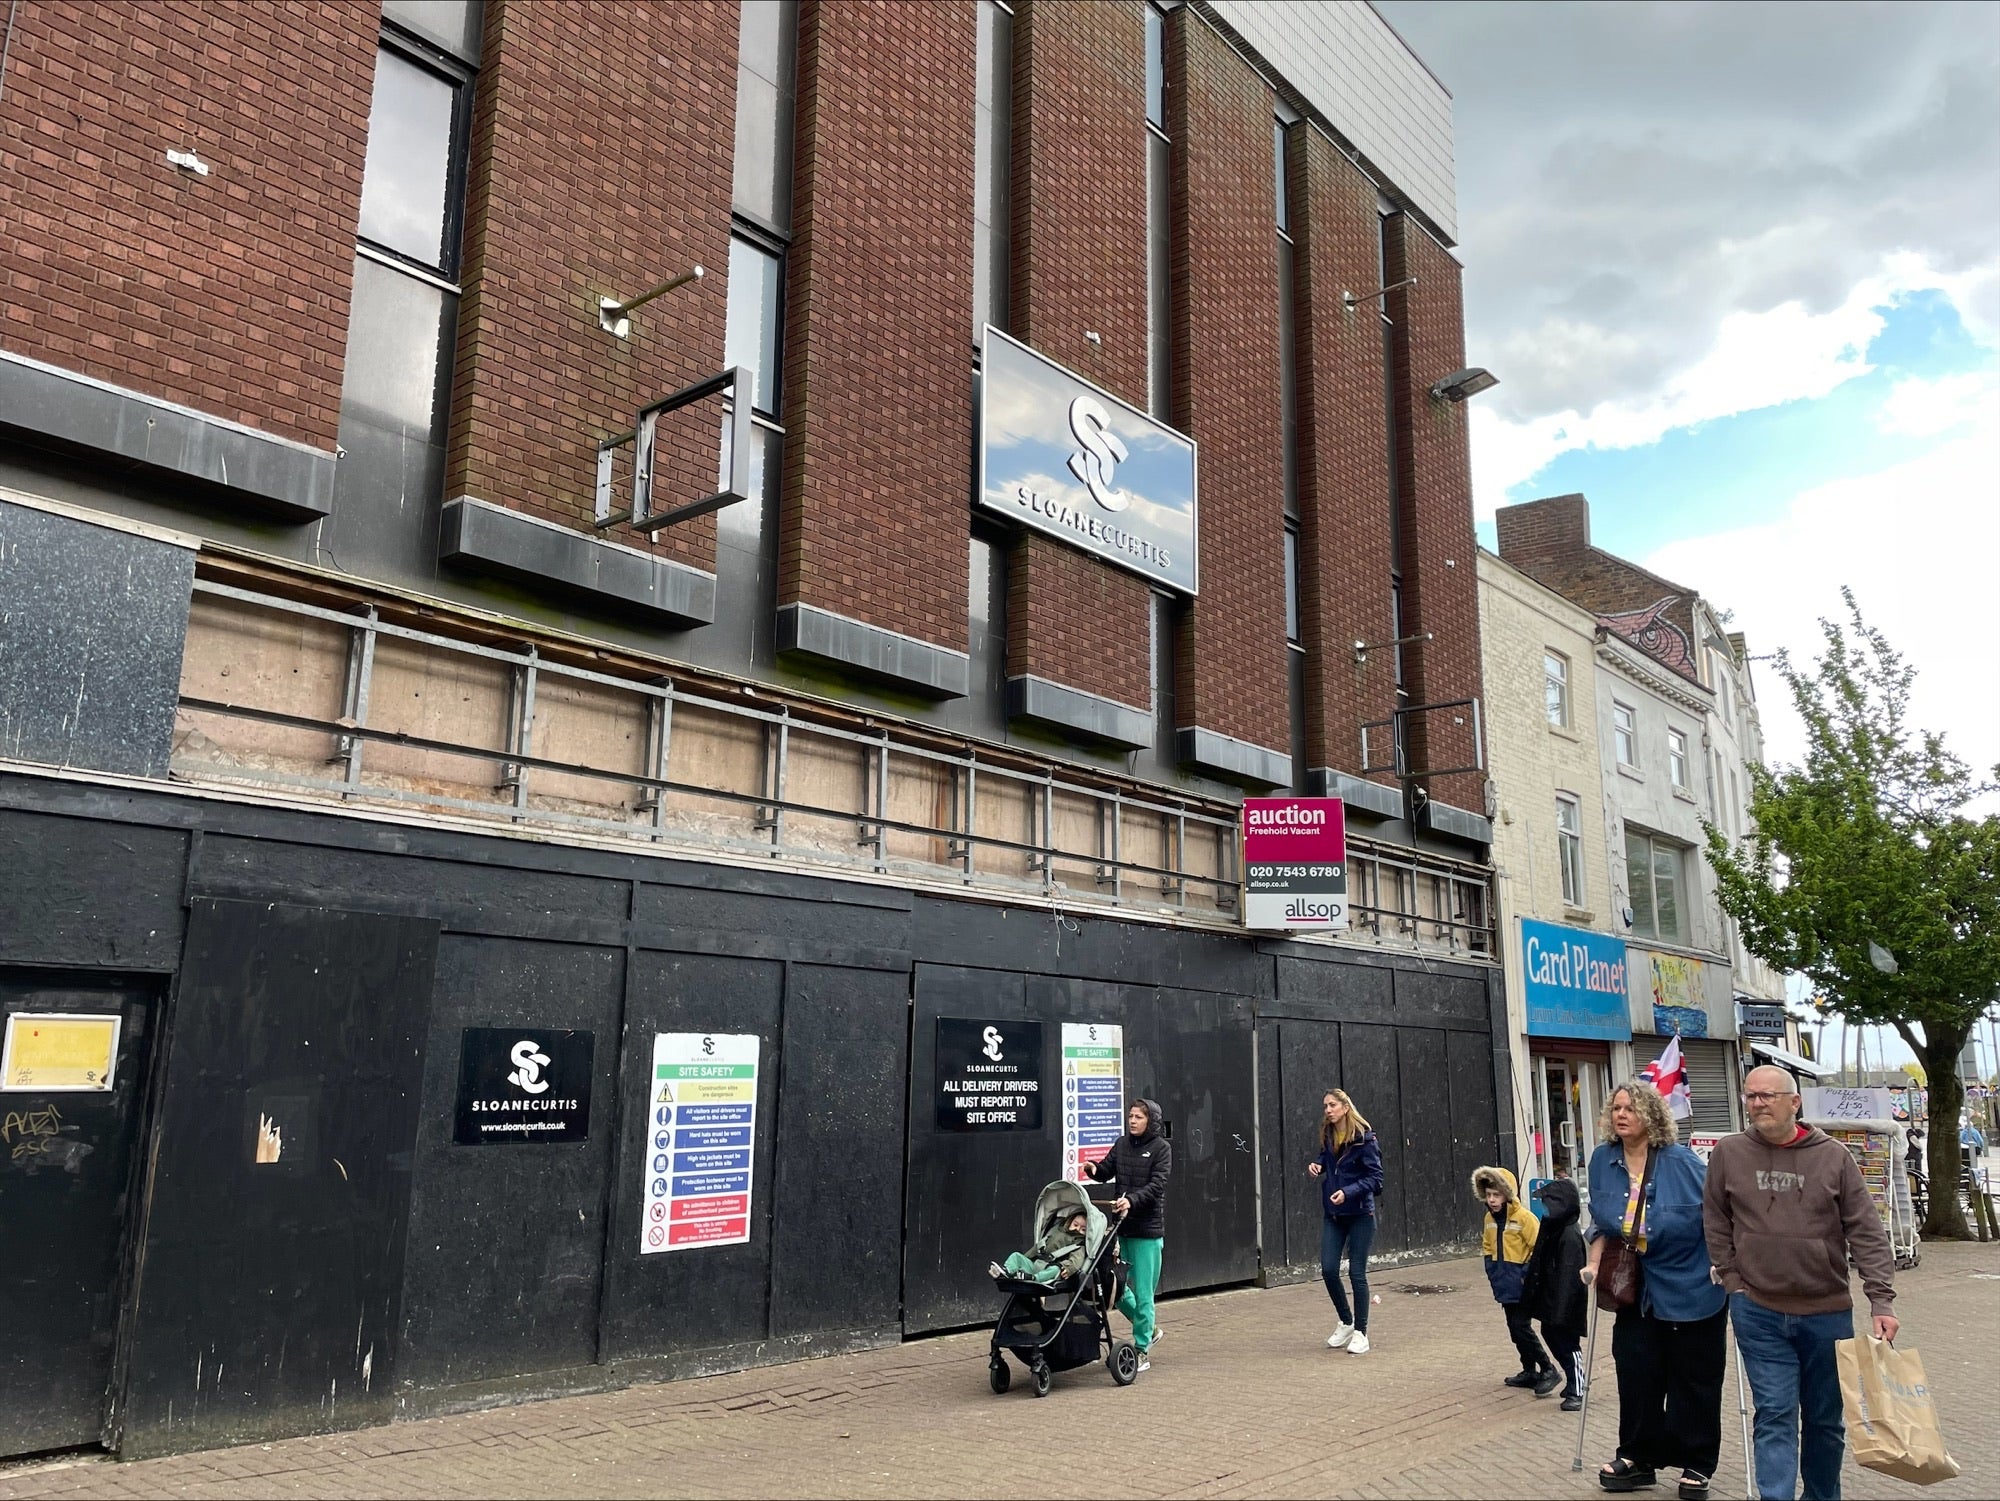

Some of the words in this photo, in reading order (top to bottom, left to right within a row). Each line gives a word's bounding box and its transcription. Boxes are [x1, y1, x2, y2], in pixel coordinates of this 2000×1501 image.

[1018, 487, 1170, 568] SLOANECURTIS
[1249, 804, 1325, 825] auction
[1249, 827, 1288, 835] Freehold
[1290, 827, 1320, 835] Vacant
[1250, 866, 1273, 877] 020
[1275, 866, 1307, 877] 7543
[1309, 866, 1340, 877] 6780
[1250, 881, 1289, 889] allsop.co.uk
[1285, 898, 1341, 922] allsop
[1527, 936, 1571, 988] Card
[1572, 945, 1627, 995] Planet
[1745, 1020, 1782, 1028] NERO
[1077, 1048, 1089, 1056] SITE
[1089, 1048, 1109, 1056] SAFETY
[679, 1066, 699, 1077] SITE
[700, 1066, 735, 1077] SAFETY
[966, 1065, 1018, 1073] SLOANECURTIS
[943, 1080, 960, 1092] ALL
[962, 1080, 1003, 1092] DELIVERY
[1004, 1081, 1038, 1092] DRIVERS
[1825, 1087, 1858, 1096] PUZZLE
[955, 1096, 979, 1108] MUST
[981, 1096, 1014, 1107] REPORT
[1015, 1096, 1027, 1107] TO
[1841, 1095, 1870, 1103] BOOKS
[472, 1100, 578, 1111] SLOANECURTIS
[967, 1112, 986, 1123] SITE
[987, 1112, 1017, 1123] OFFICE
[1826, 1109, 1837, 1118] 4
[1841, 1109, 1855, 1117] for
[1854, 1110, 1872, 1119] £5
[480, 1121, 566, 1132] www.sloanecurtis.co.uk
[706, 1154, 722, 1162] jackets
